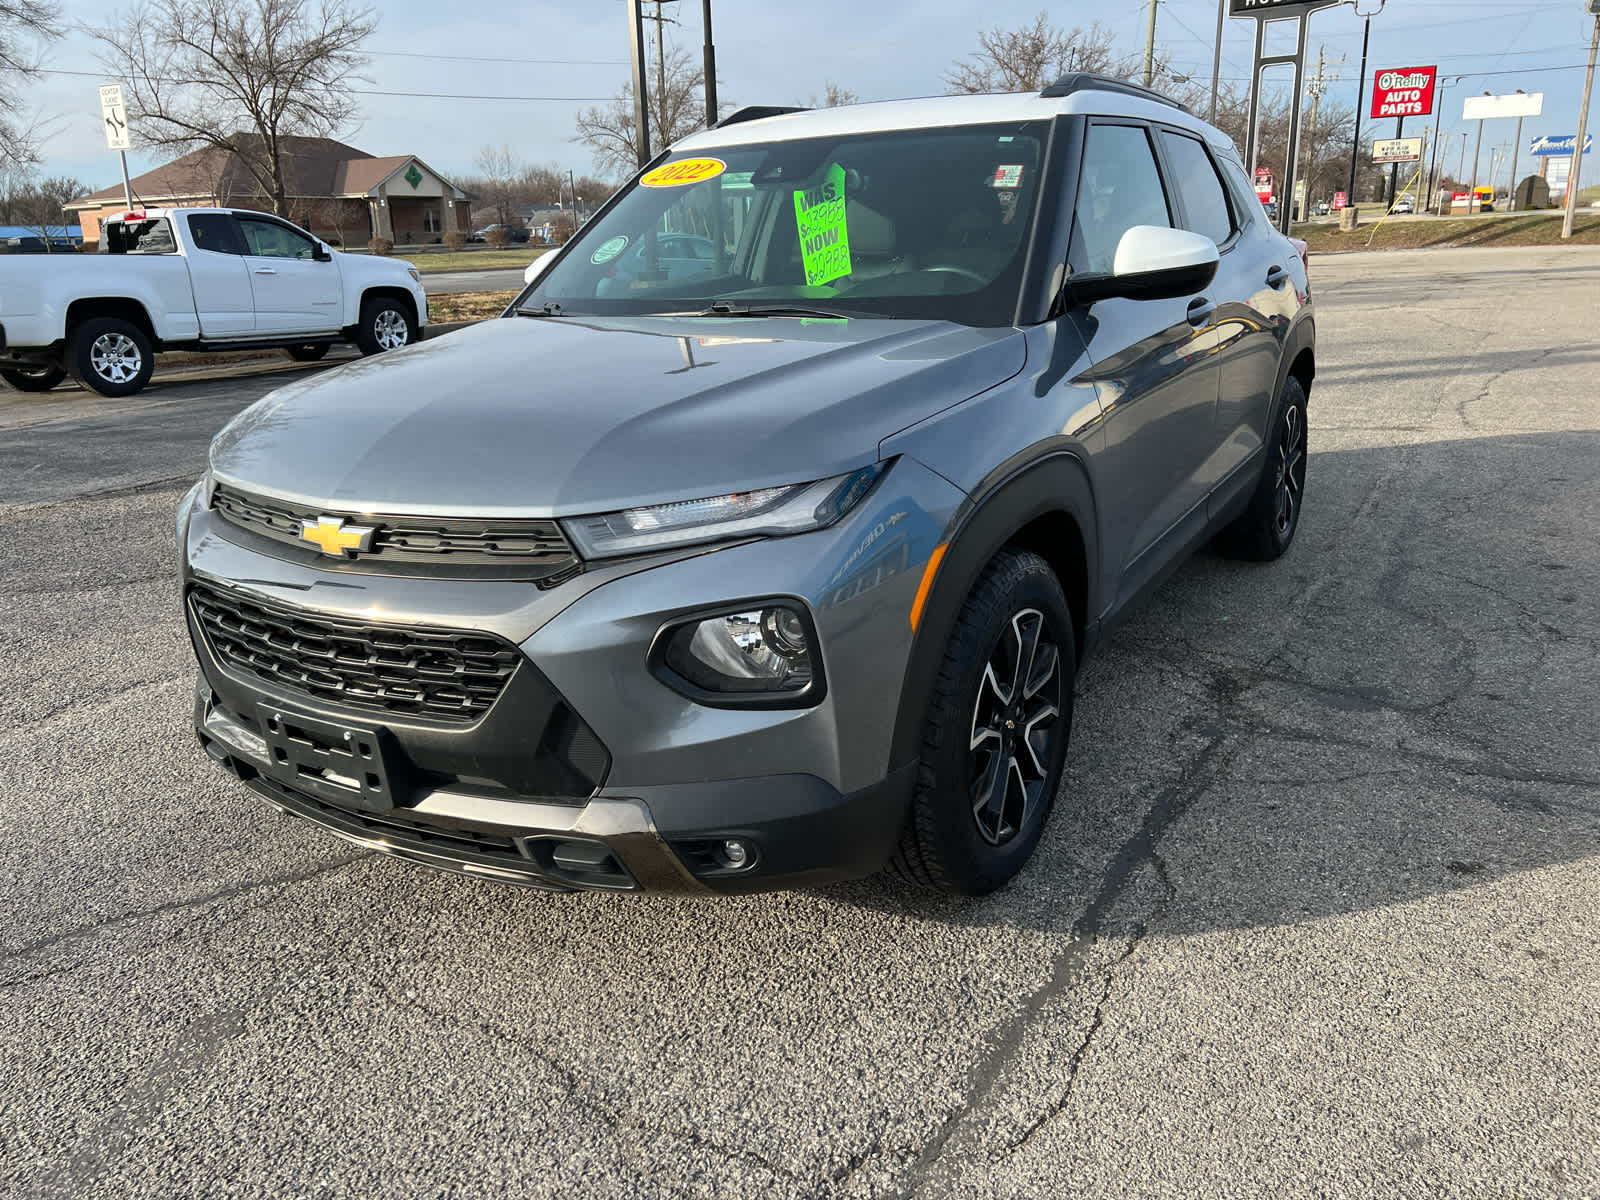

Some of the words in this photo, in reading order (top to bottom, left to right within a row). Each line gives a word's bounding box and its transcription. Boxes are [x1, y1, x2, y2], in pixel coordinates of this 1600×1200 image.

[1379, 72, 1430, 90] O'Reilly
[1385, 90, 1420, 103] AUTO
[1380, 101, 1422, 115] PARTS
[648, 163, 715, 183] 2022
[800, 183, 836, 212] WAS
[804, 226, 839, 256] NOW
